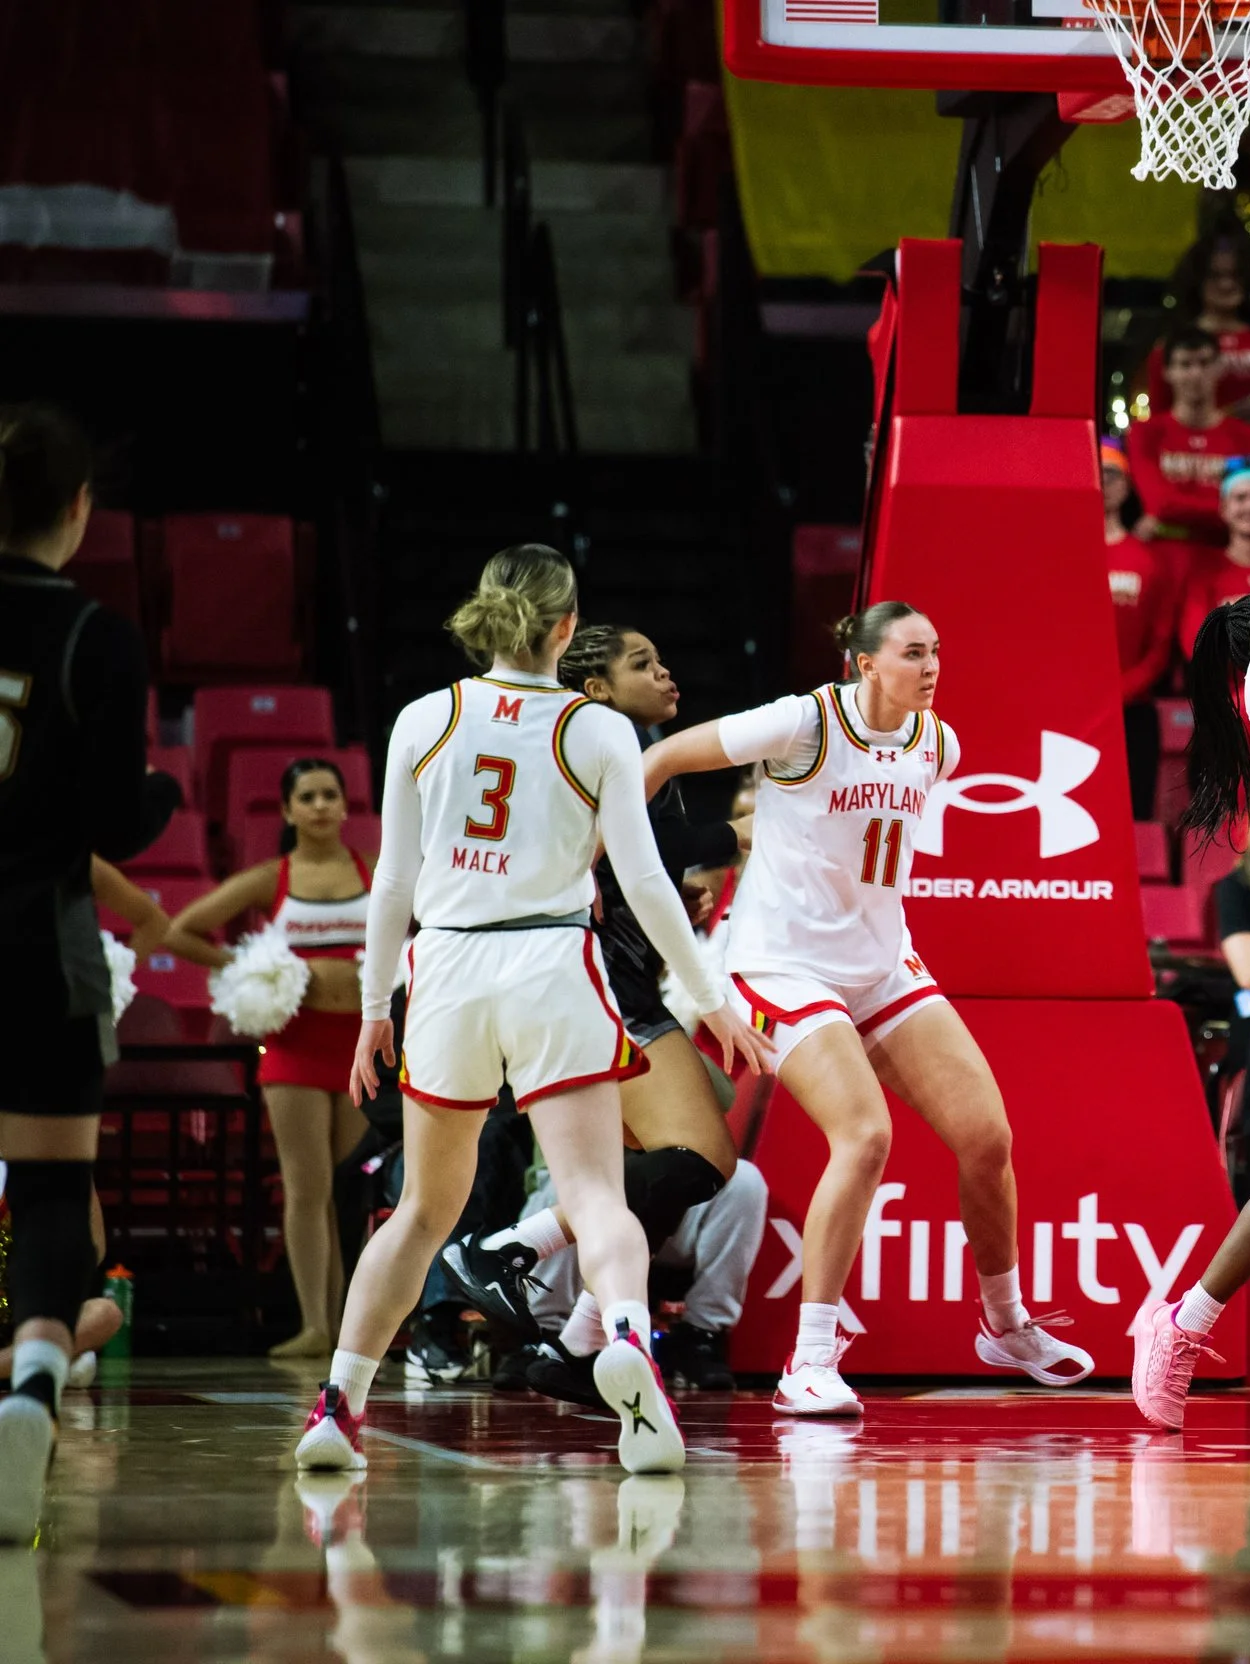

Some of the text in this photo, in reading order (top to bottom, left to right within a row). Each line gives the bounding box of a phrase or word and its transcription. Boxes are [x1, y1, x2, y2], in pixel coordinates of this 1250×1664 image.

[493, 695, 525, 722] M
[464, 754, 516, 841] 3
[452, 847, 511, 876] MACK
[861, 818, 903, 888] 11
[902, 878, 1113, 900] DER ARMOUR
